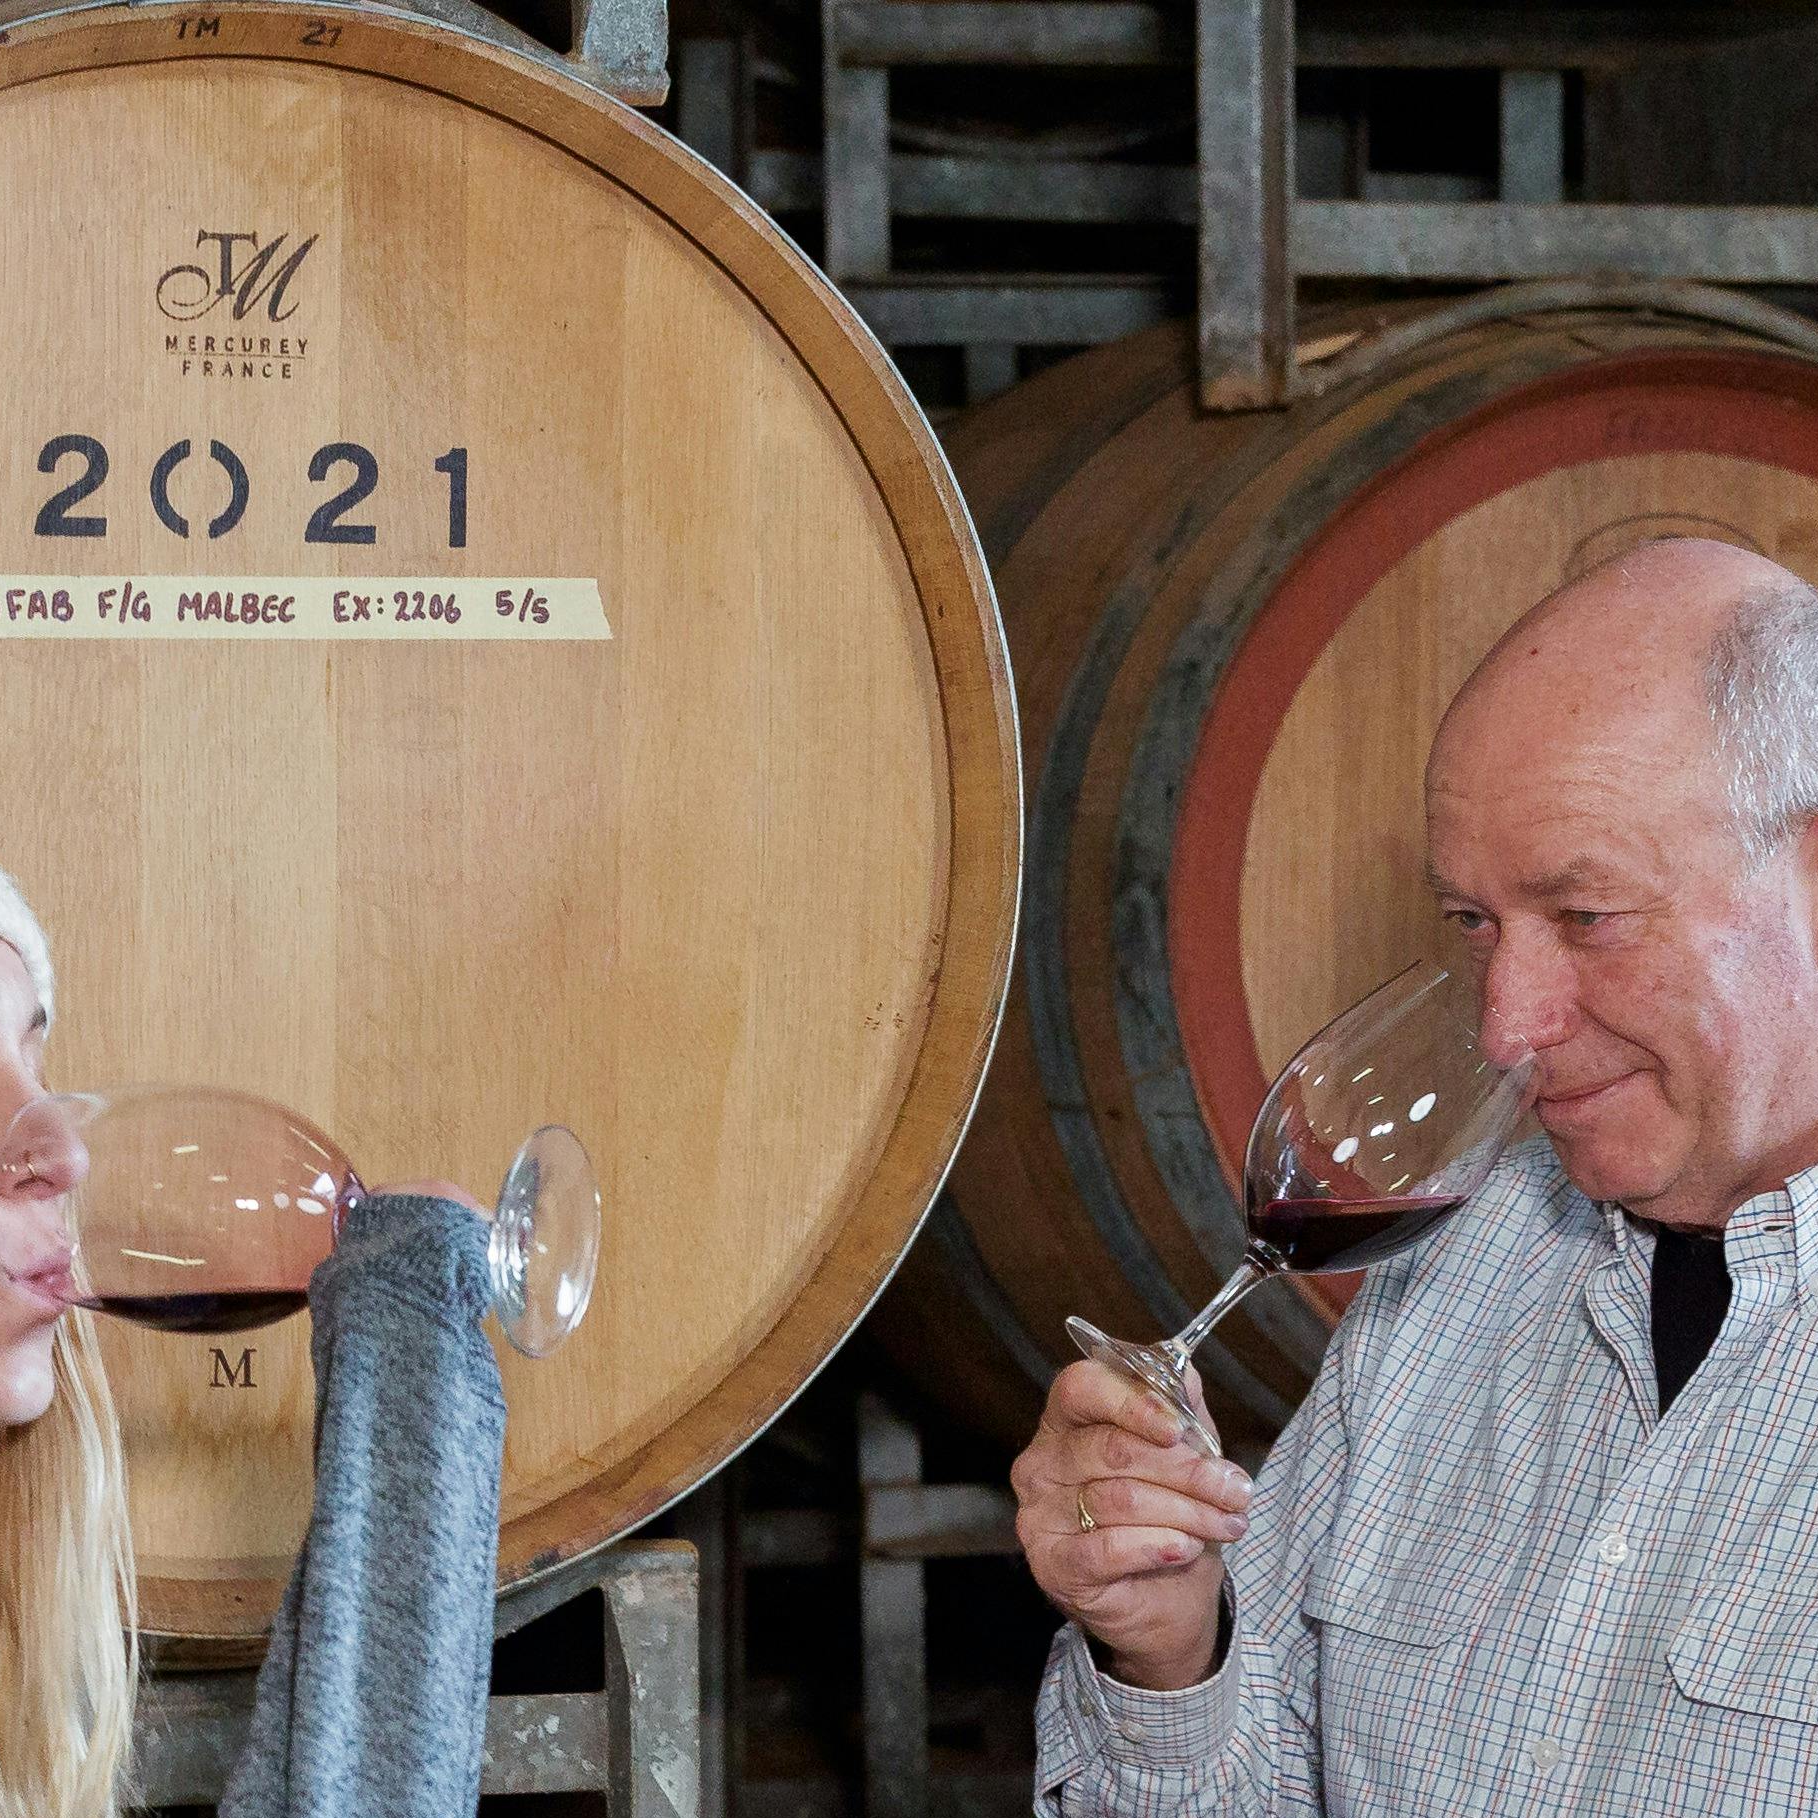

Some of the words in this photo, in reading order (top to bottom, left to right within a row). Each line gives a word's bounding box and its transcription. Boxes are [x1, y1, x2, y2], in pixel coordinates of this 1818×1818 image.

[165, 335, 309, 356] MERCUREY
[181, 360, 293, 380] FRANCE
[34, 433, 469, 548] 2021
[177, 596, 296, 623] MALBEC
[494, 589, 551, 625] 5/5
[208, 1347, 258, 1389] M
